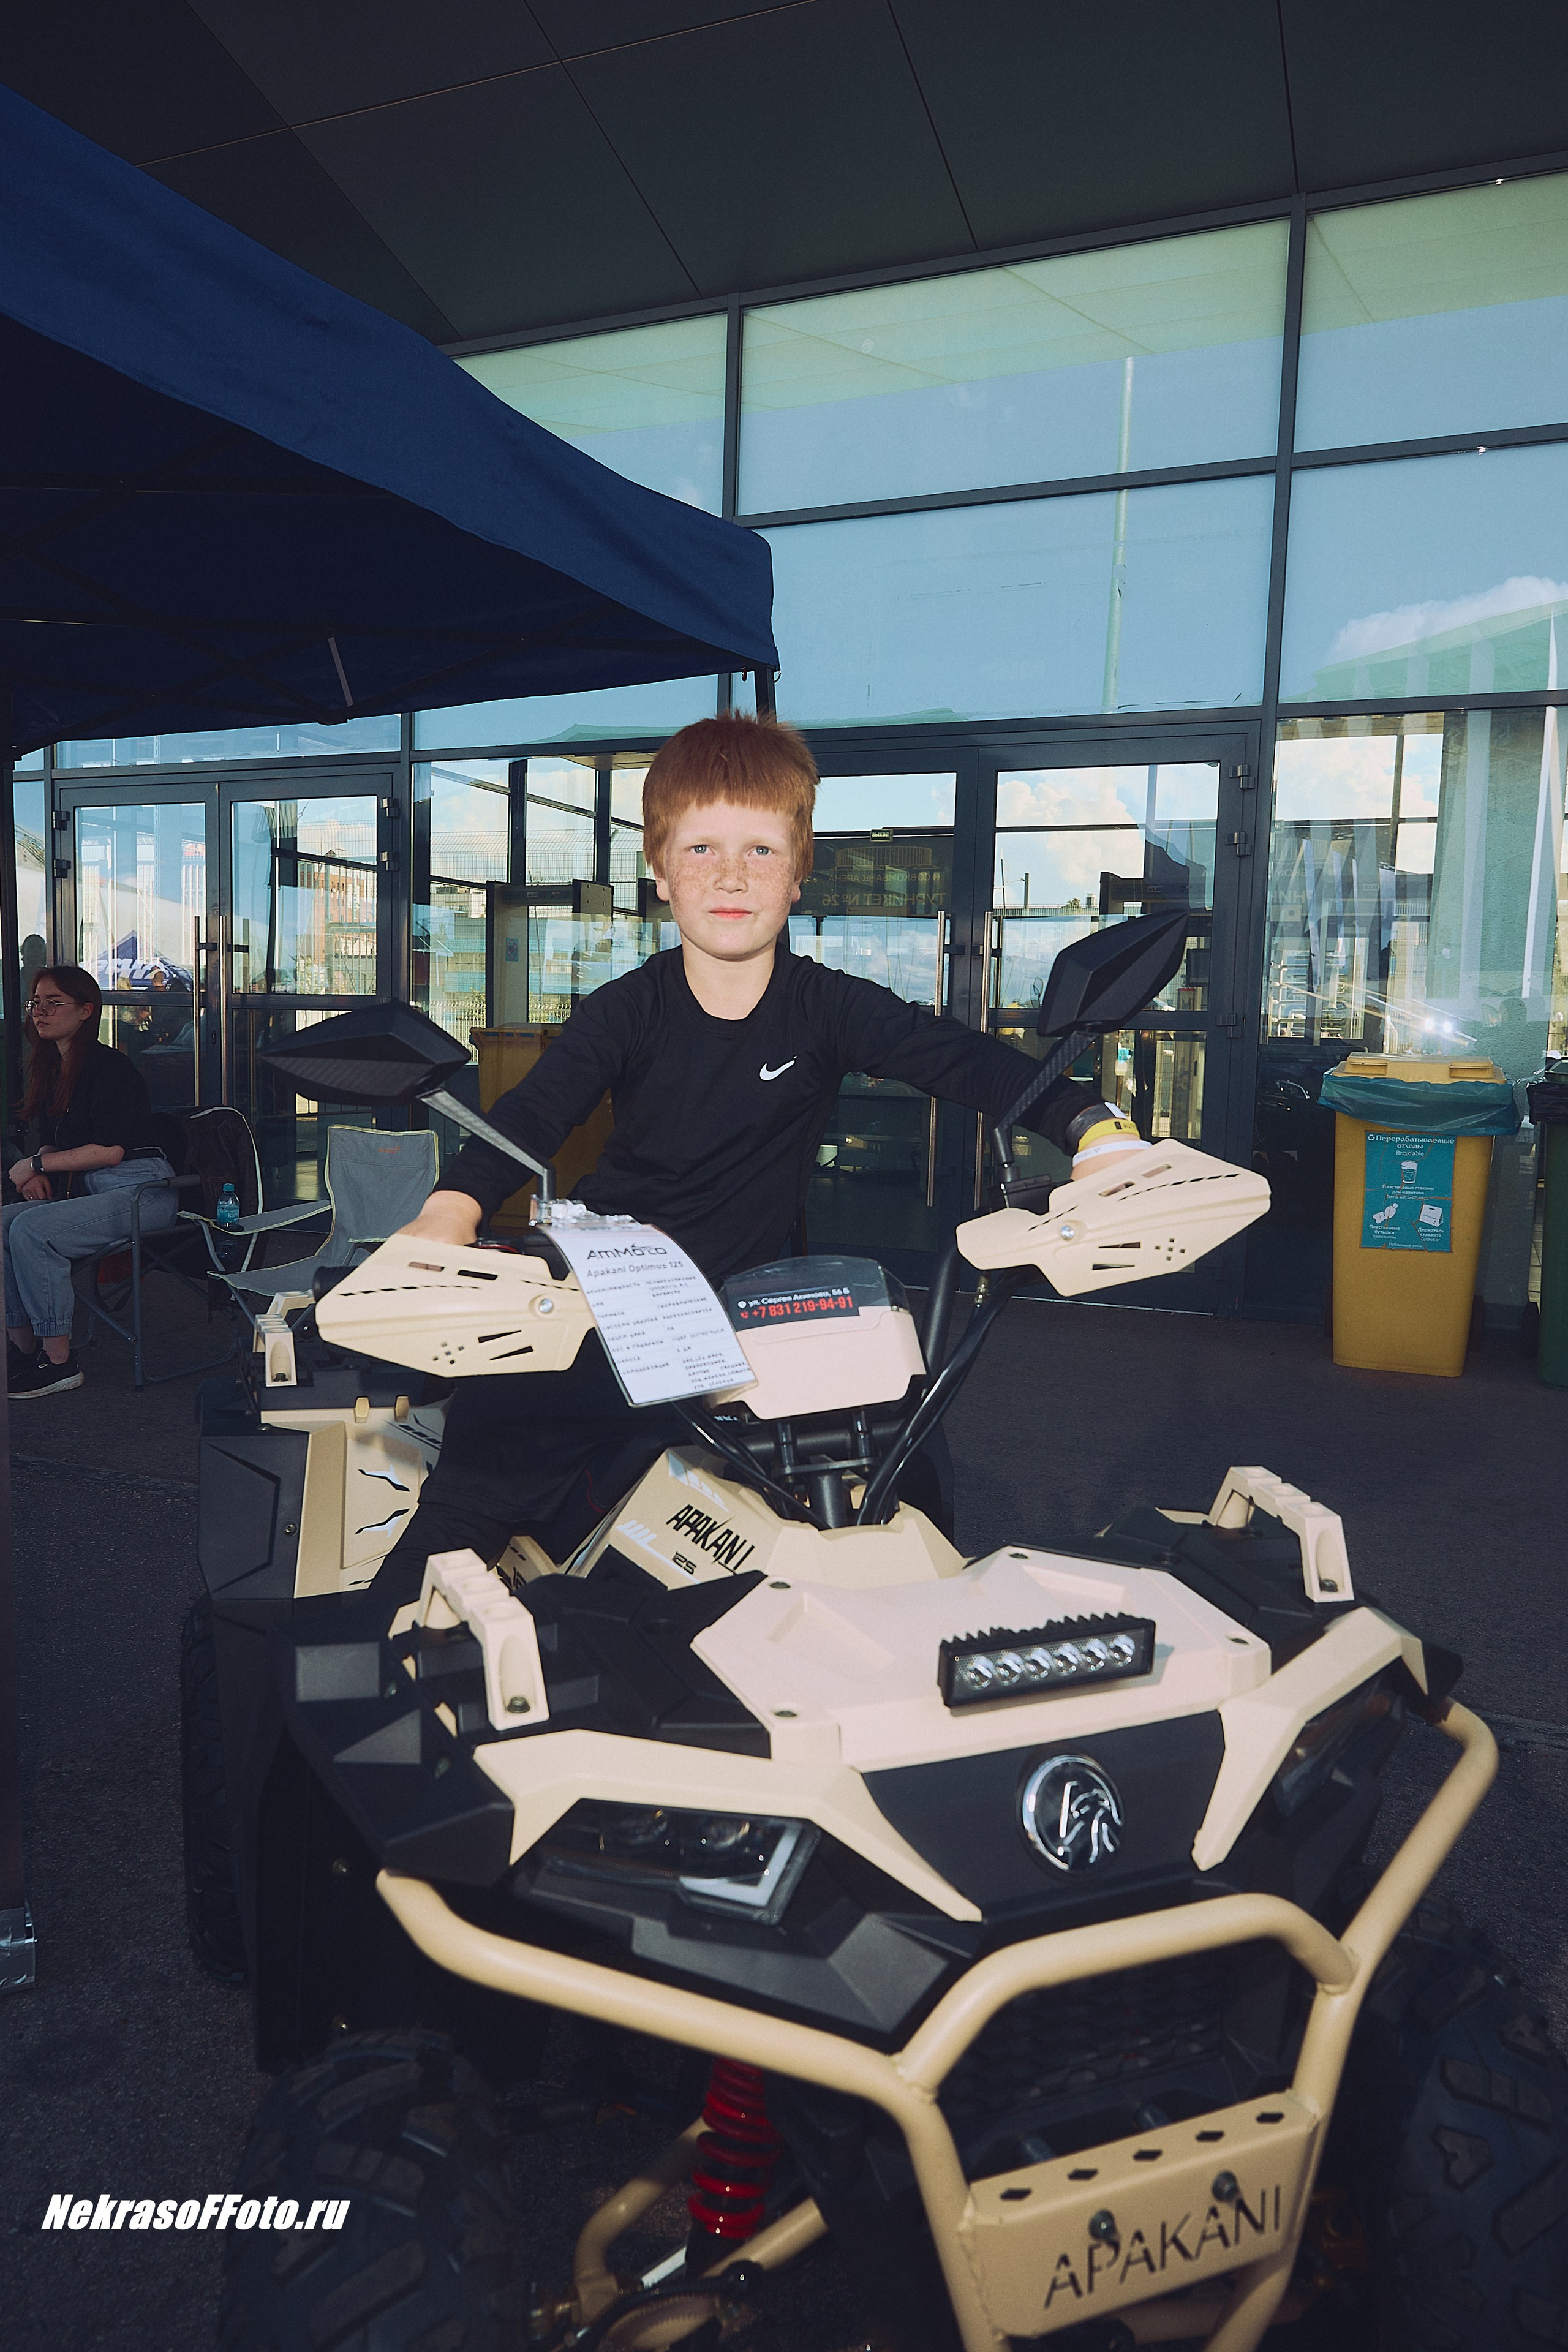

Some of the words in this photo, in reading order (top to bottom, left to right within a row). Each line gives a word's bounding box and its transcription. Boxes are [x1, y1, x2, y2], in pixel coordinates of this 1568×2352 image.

[1376, 1134, 1455, 1144] Перерабатываемые
[587, 1265, 626, 1278] Apakani
[629, 1263, 666, 1273] Optimus
[752, 1306, 766, 1319] +7
[768, 1302, 791, 1317] 831
[666, 1504, 755, 1570] APAKANI
[1044, 2184, 1280, 2309] APAKANI
